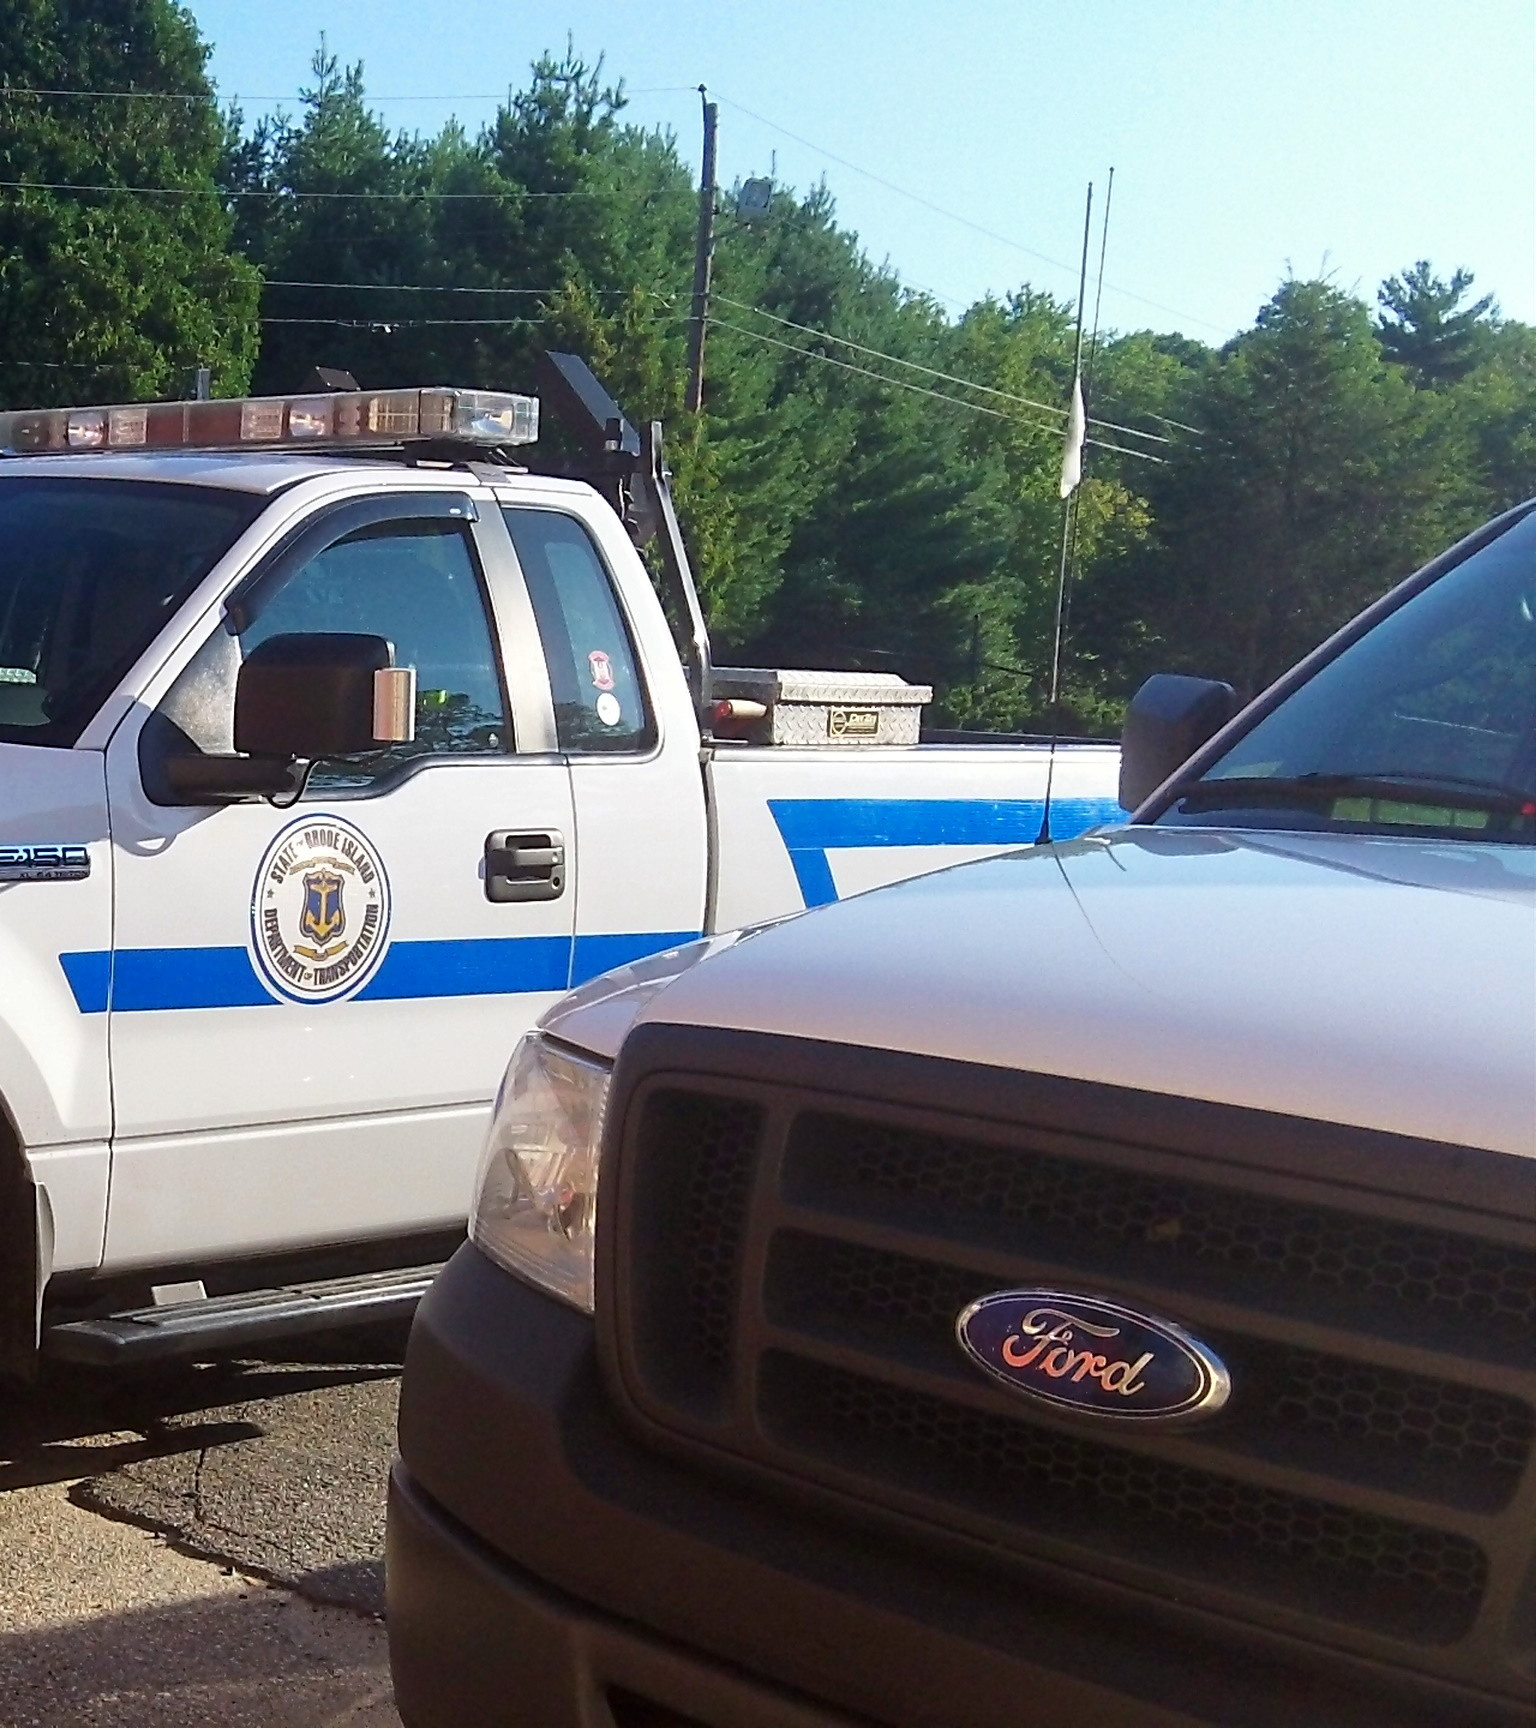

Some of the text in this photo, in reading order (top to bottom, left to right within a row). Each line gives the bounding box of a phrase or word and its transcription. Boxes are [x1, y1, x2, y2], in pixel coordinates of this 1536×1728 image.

[270, 840, 298, 884] STATE
[304, 828, 340, 850] RHODE
[341, 837, 375, 884] ISLAND
[264, 907, 307, 983] DEPARTMENT
[312, 903, 380, 986] TRANSPORTATION
[1001, 1307, 1156, 1397] Ford
